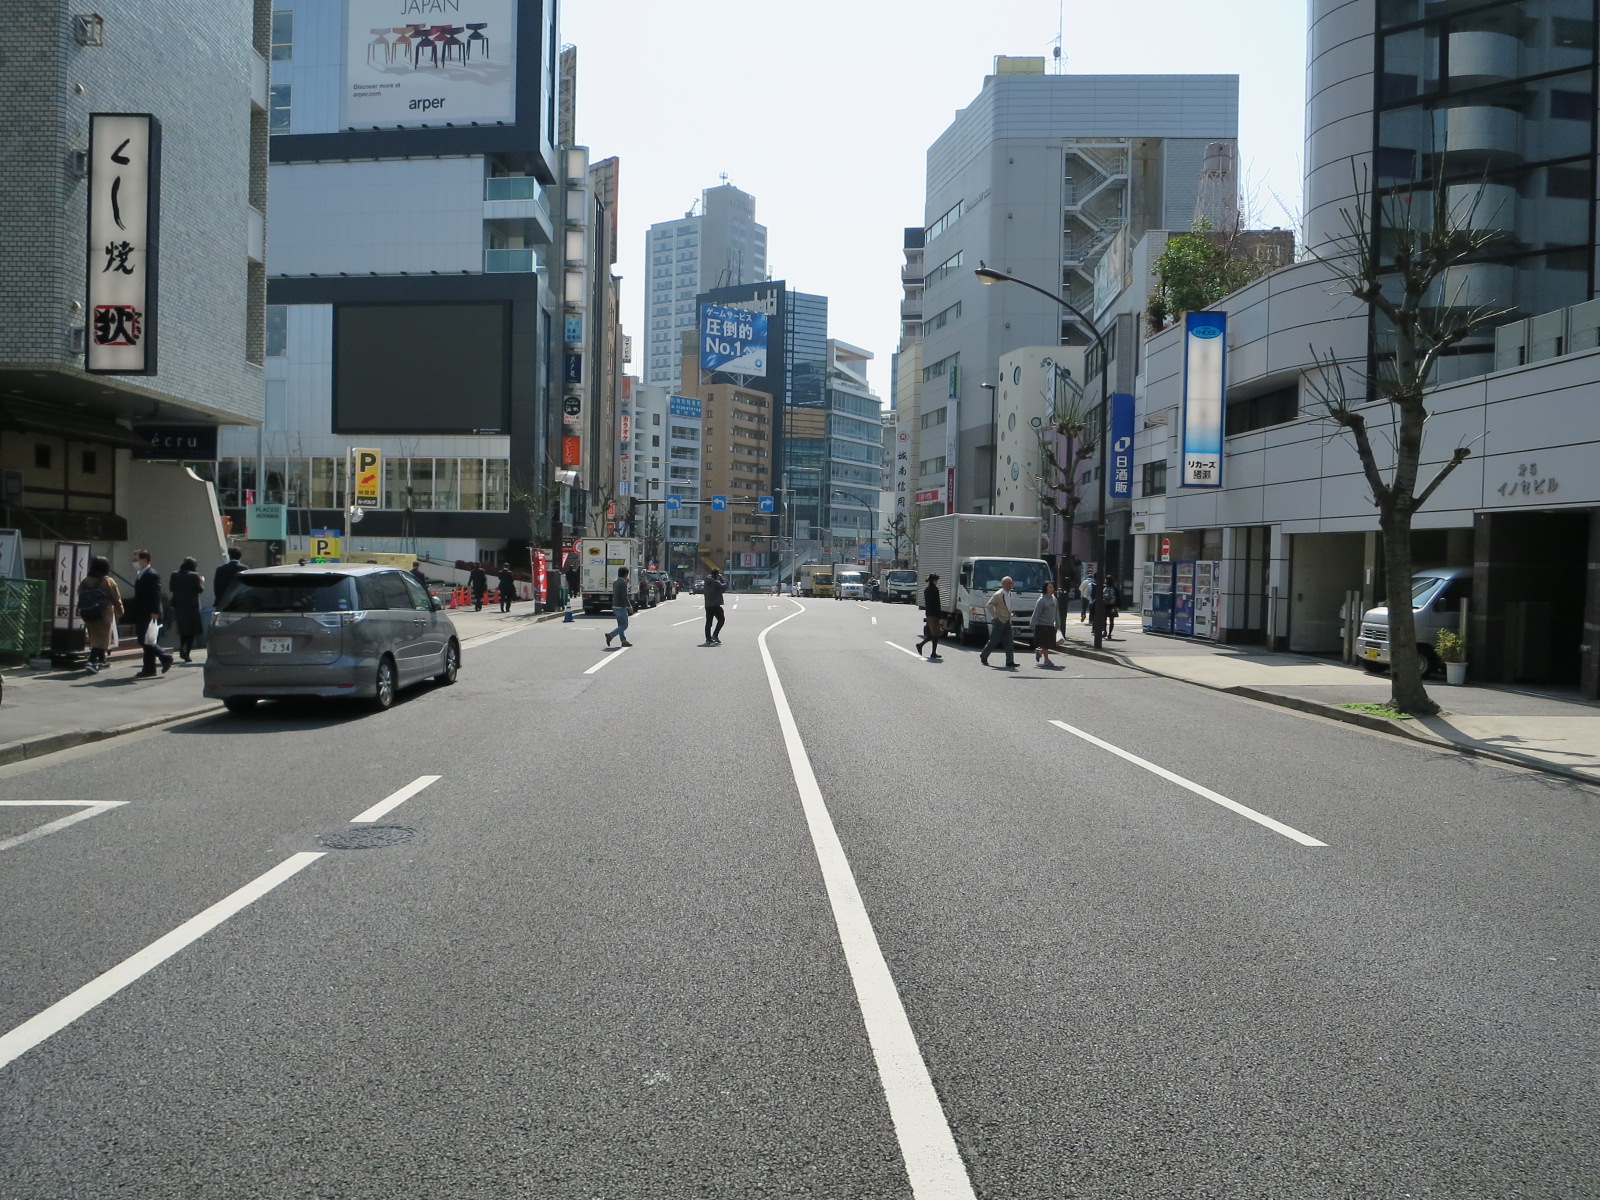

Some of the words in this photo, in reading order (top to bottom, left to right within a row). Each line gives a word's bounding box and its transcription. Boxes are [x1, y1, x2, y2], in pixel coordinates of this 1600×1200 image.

[401, 0, 459, 15] JAPAN
[408, 97, 446, 112] arper
[103, 138, 136, 276] くし焼
[706, 307, 753, 322] ゲームサービス
[705, 318, 753, 341] 圧倒的
[151, 432, 197, 448] écru
[360, 452, 377, 473] P
[1188, 460, 1216, 469] リカーズ
[1114, 455, 1128, 494] 日酒販
[897, 451, 907, 538] 城南信用金
[1497, 477, 1560, 497] イノセビル
[316, 539, 329, 556] P
[58, 556, 69, 596] くし焼
